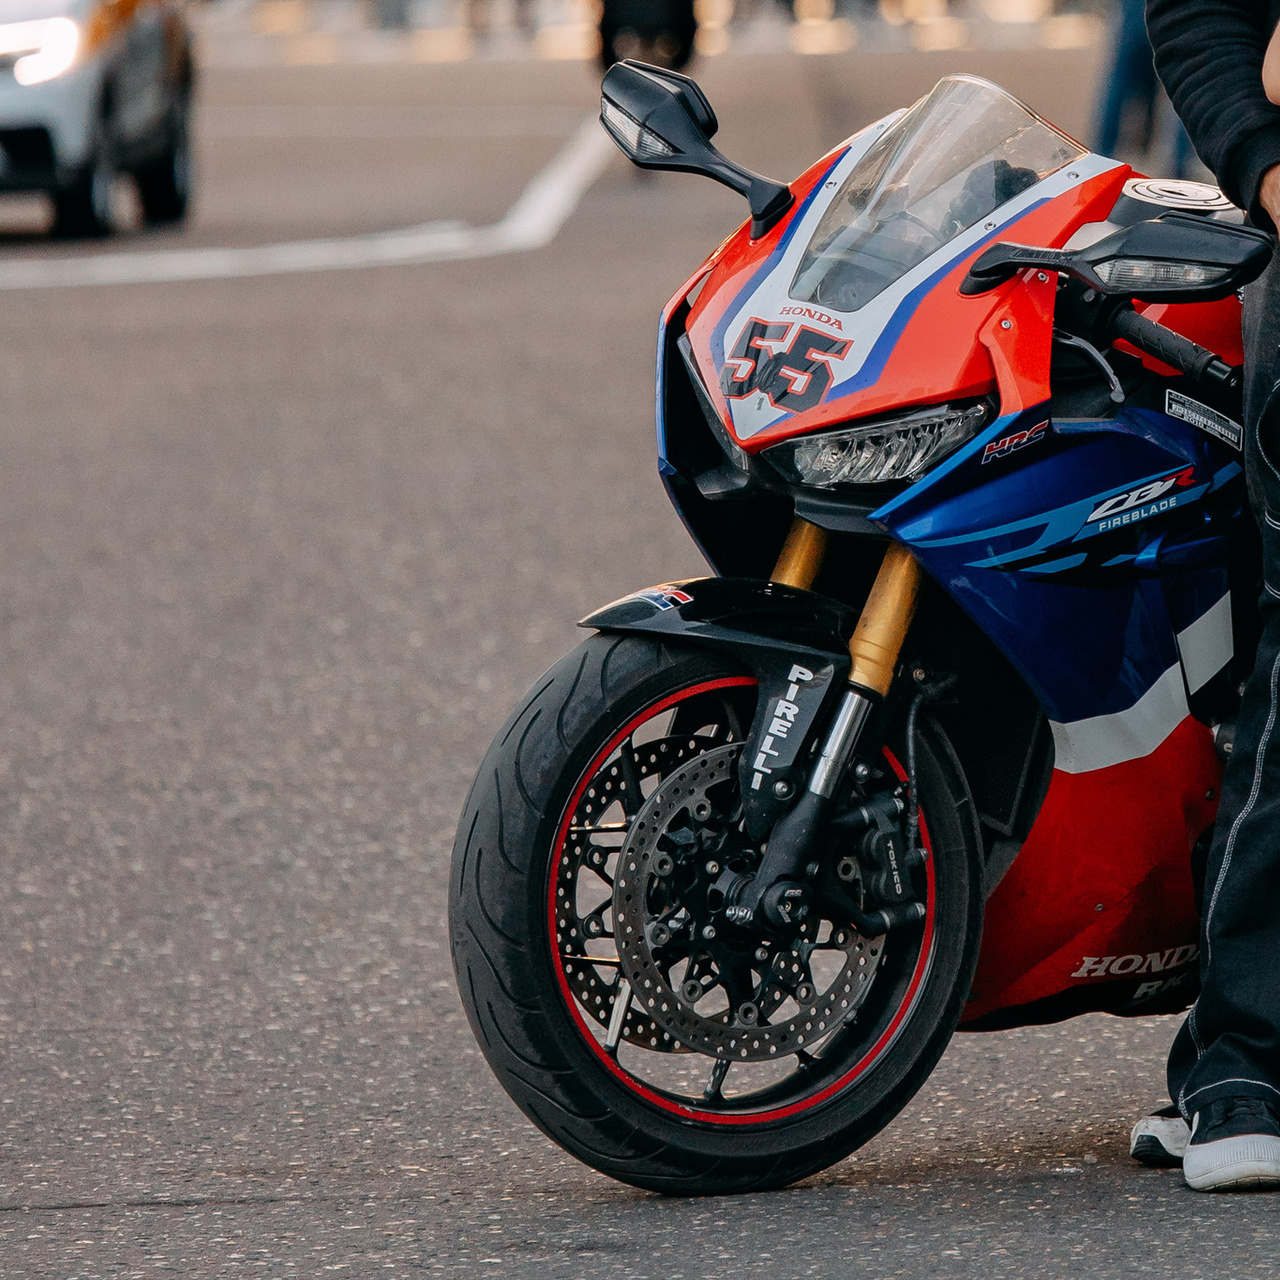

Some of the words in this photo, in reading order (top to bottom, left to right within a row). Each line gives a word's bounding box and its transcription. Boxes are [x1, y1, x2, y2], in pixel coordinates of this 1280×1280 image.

[778, 306, 844, 331] HONDA
[719, 317, 855, 413] 55
[981, 419, 1049, 465] HRC
[1099, 497, 1177, 531] FIREBLADE
[751, 664, 814, 791] PIRELLI
[887, 839, 903, 895] TOKICO
